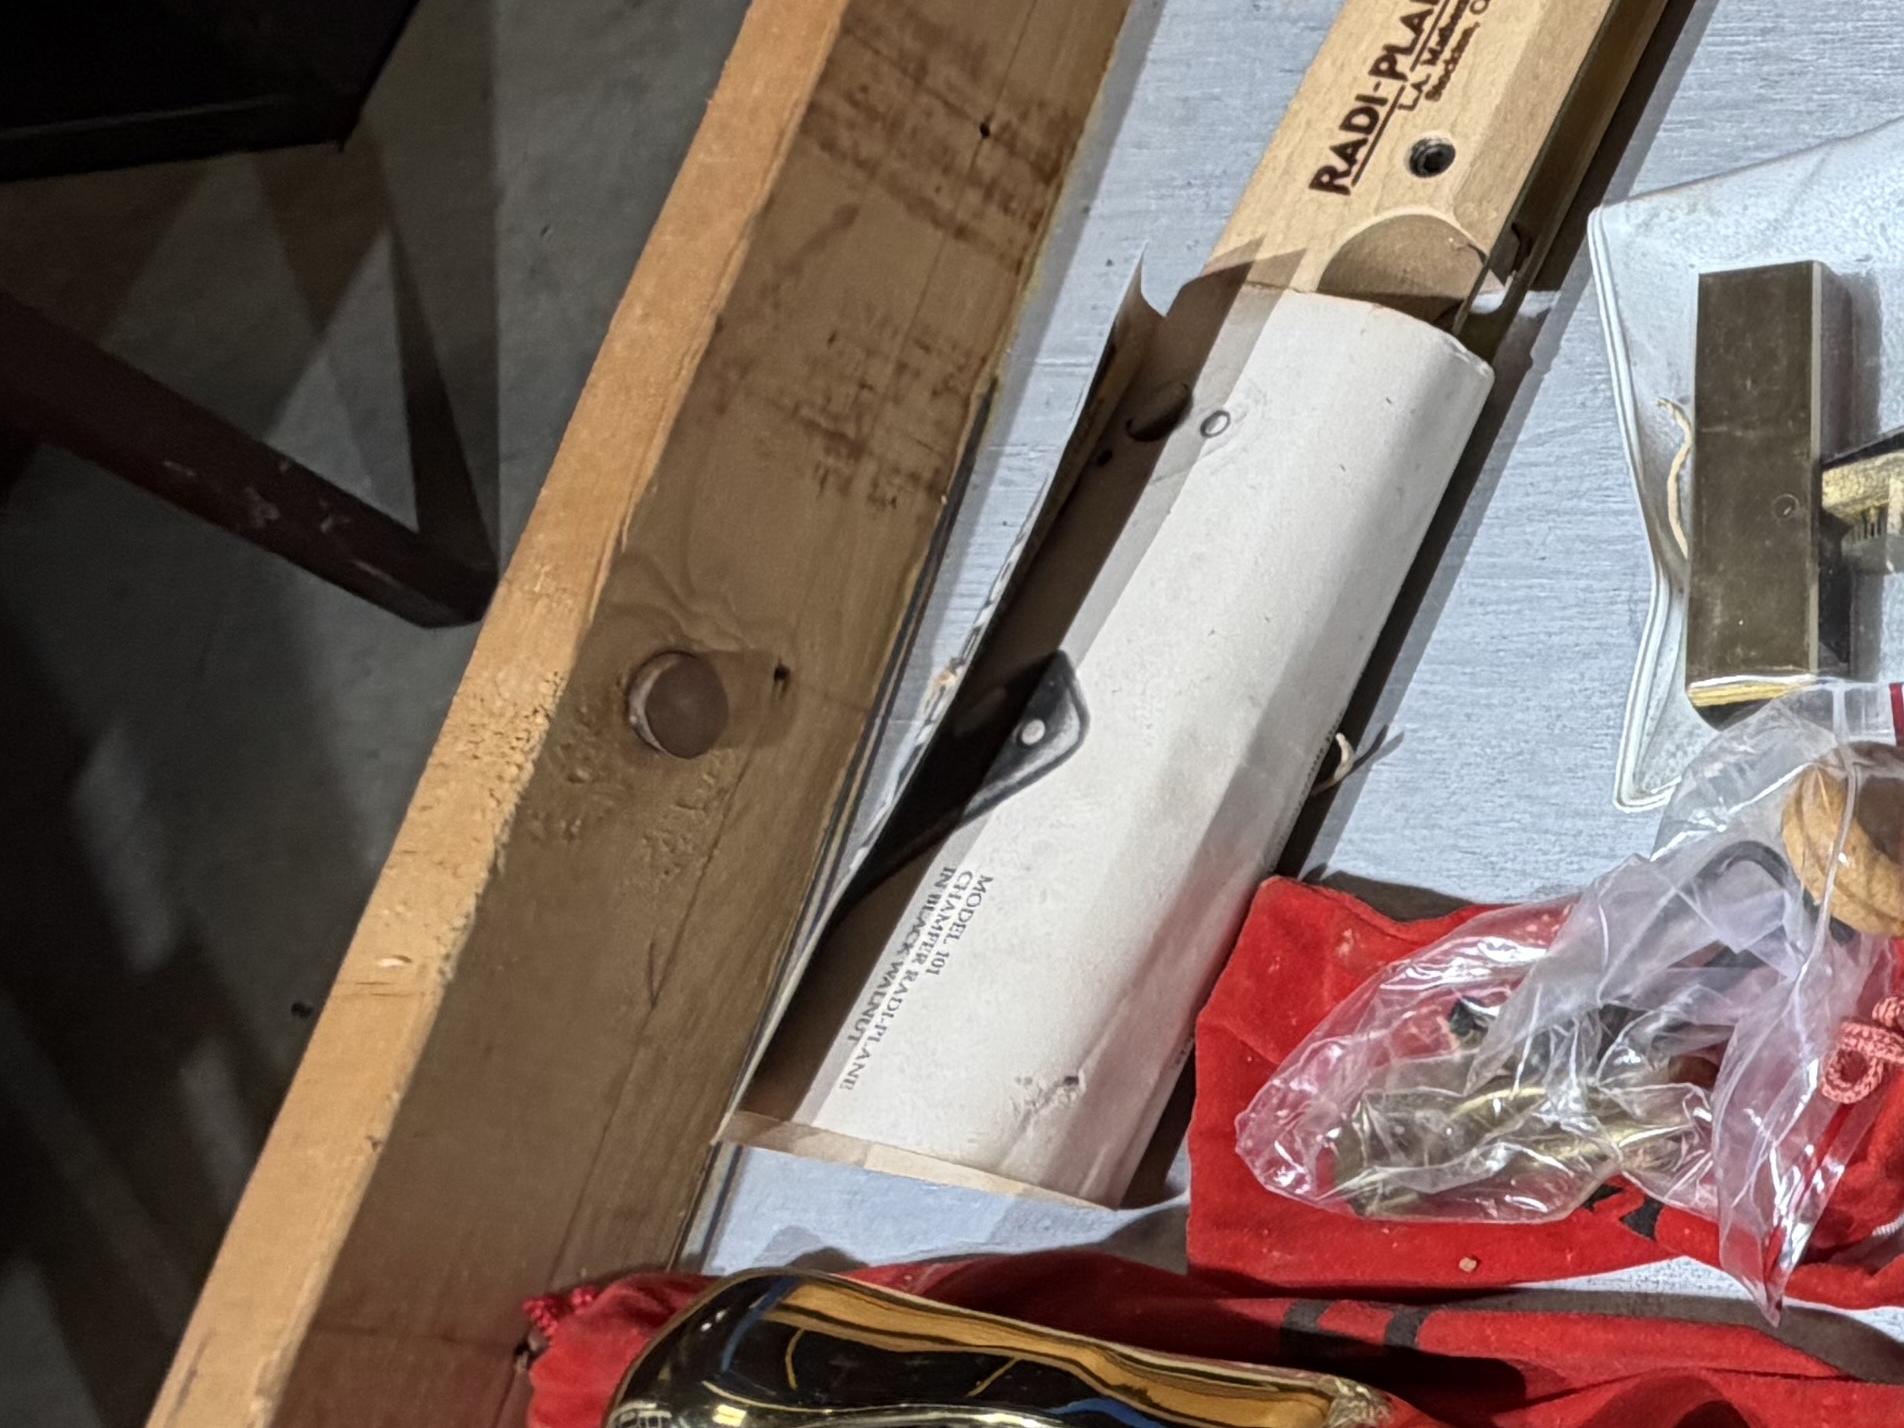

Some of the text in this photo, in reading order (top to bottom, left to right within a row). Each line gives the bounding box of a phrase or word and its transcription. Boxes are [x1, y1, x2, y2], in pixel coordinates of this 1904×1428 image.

[839, 870, 973, 1091] CHAMFER RADI-PLANE
[847, 866, 956, 1043] IN BLACK WALNUT
[925, 874, 994, 976] MODEL 101
